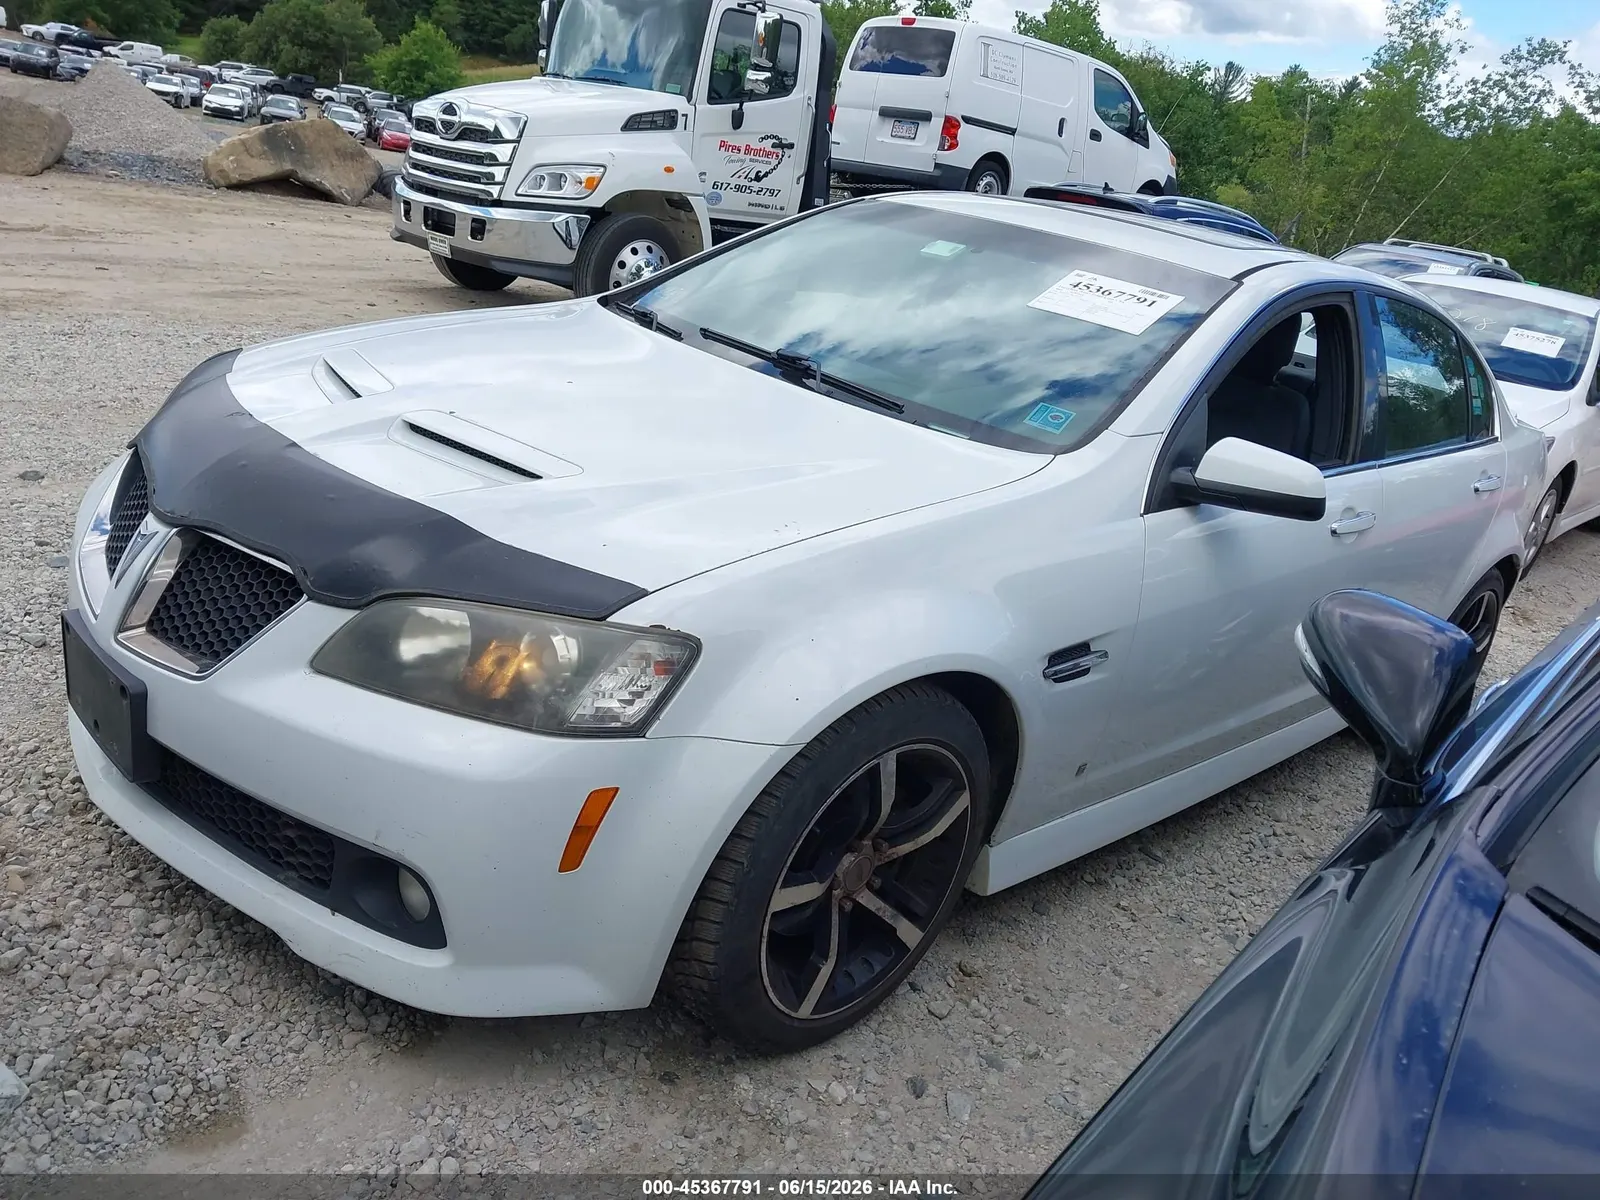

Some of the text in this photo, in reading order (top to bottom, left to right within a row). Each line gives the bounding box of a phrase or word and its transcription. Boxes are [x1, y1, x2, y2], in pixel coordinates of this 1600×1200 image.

[681, 113, 689, 131] 7
[718, 140, 780, 160] Pires Brothers
[722, 154, 747, 167] Towing
[711, 180, 782, 198] 617-905-2797
[1069, 280, 1158, 308] 45367791
